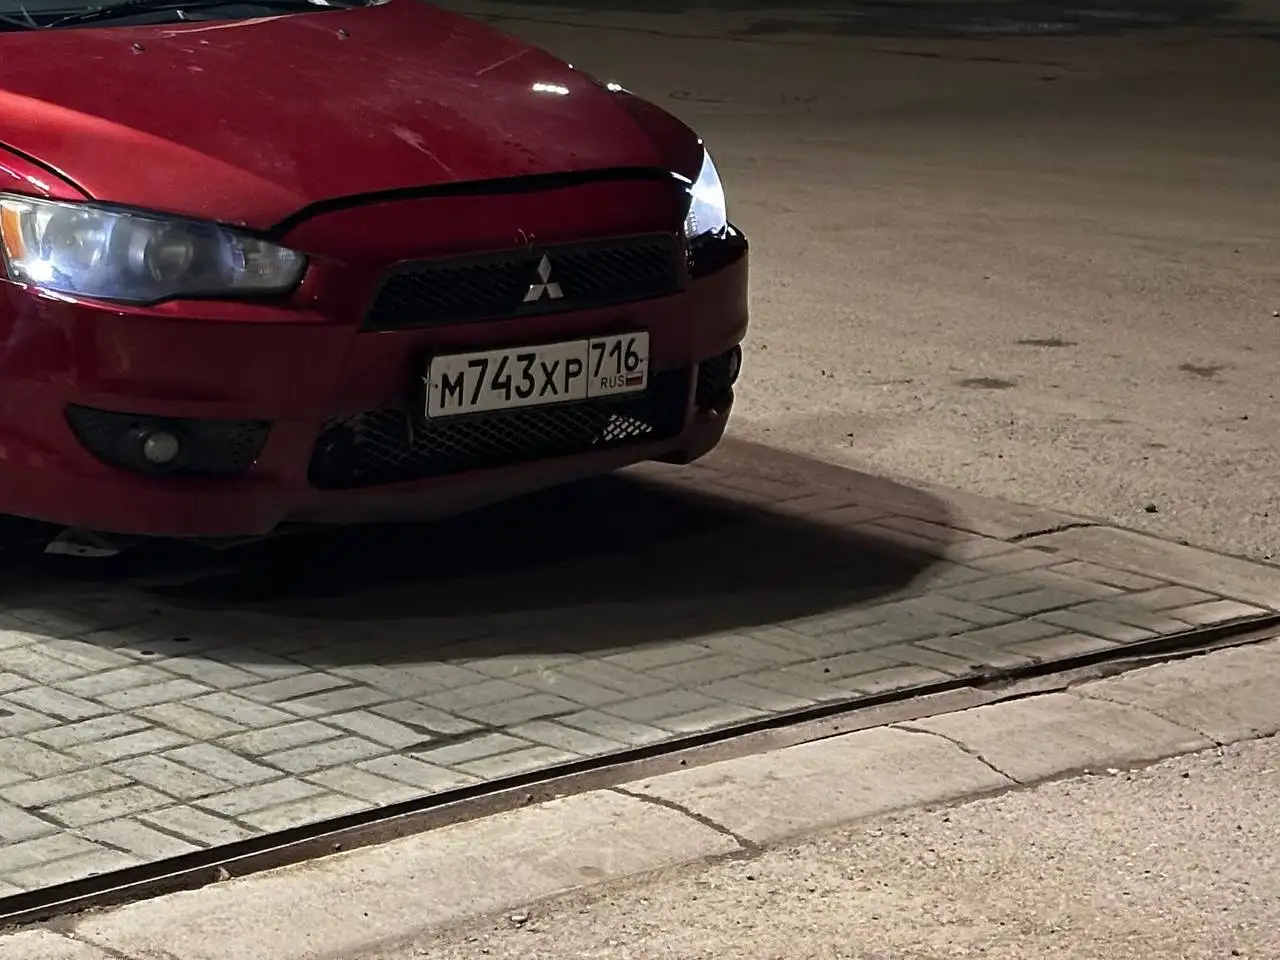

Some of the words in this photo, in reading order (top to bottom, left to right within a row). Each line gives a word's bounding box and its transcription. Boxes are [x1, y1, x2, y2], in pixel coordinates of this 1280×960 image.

[440, 353, 582, 408] М743ХР
[592, 338, 639, 378] 716
[601, 375, 625, 388] RUS
